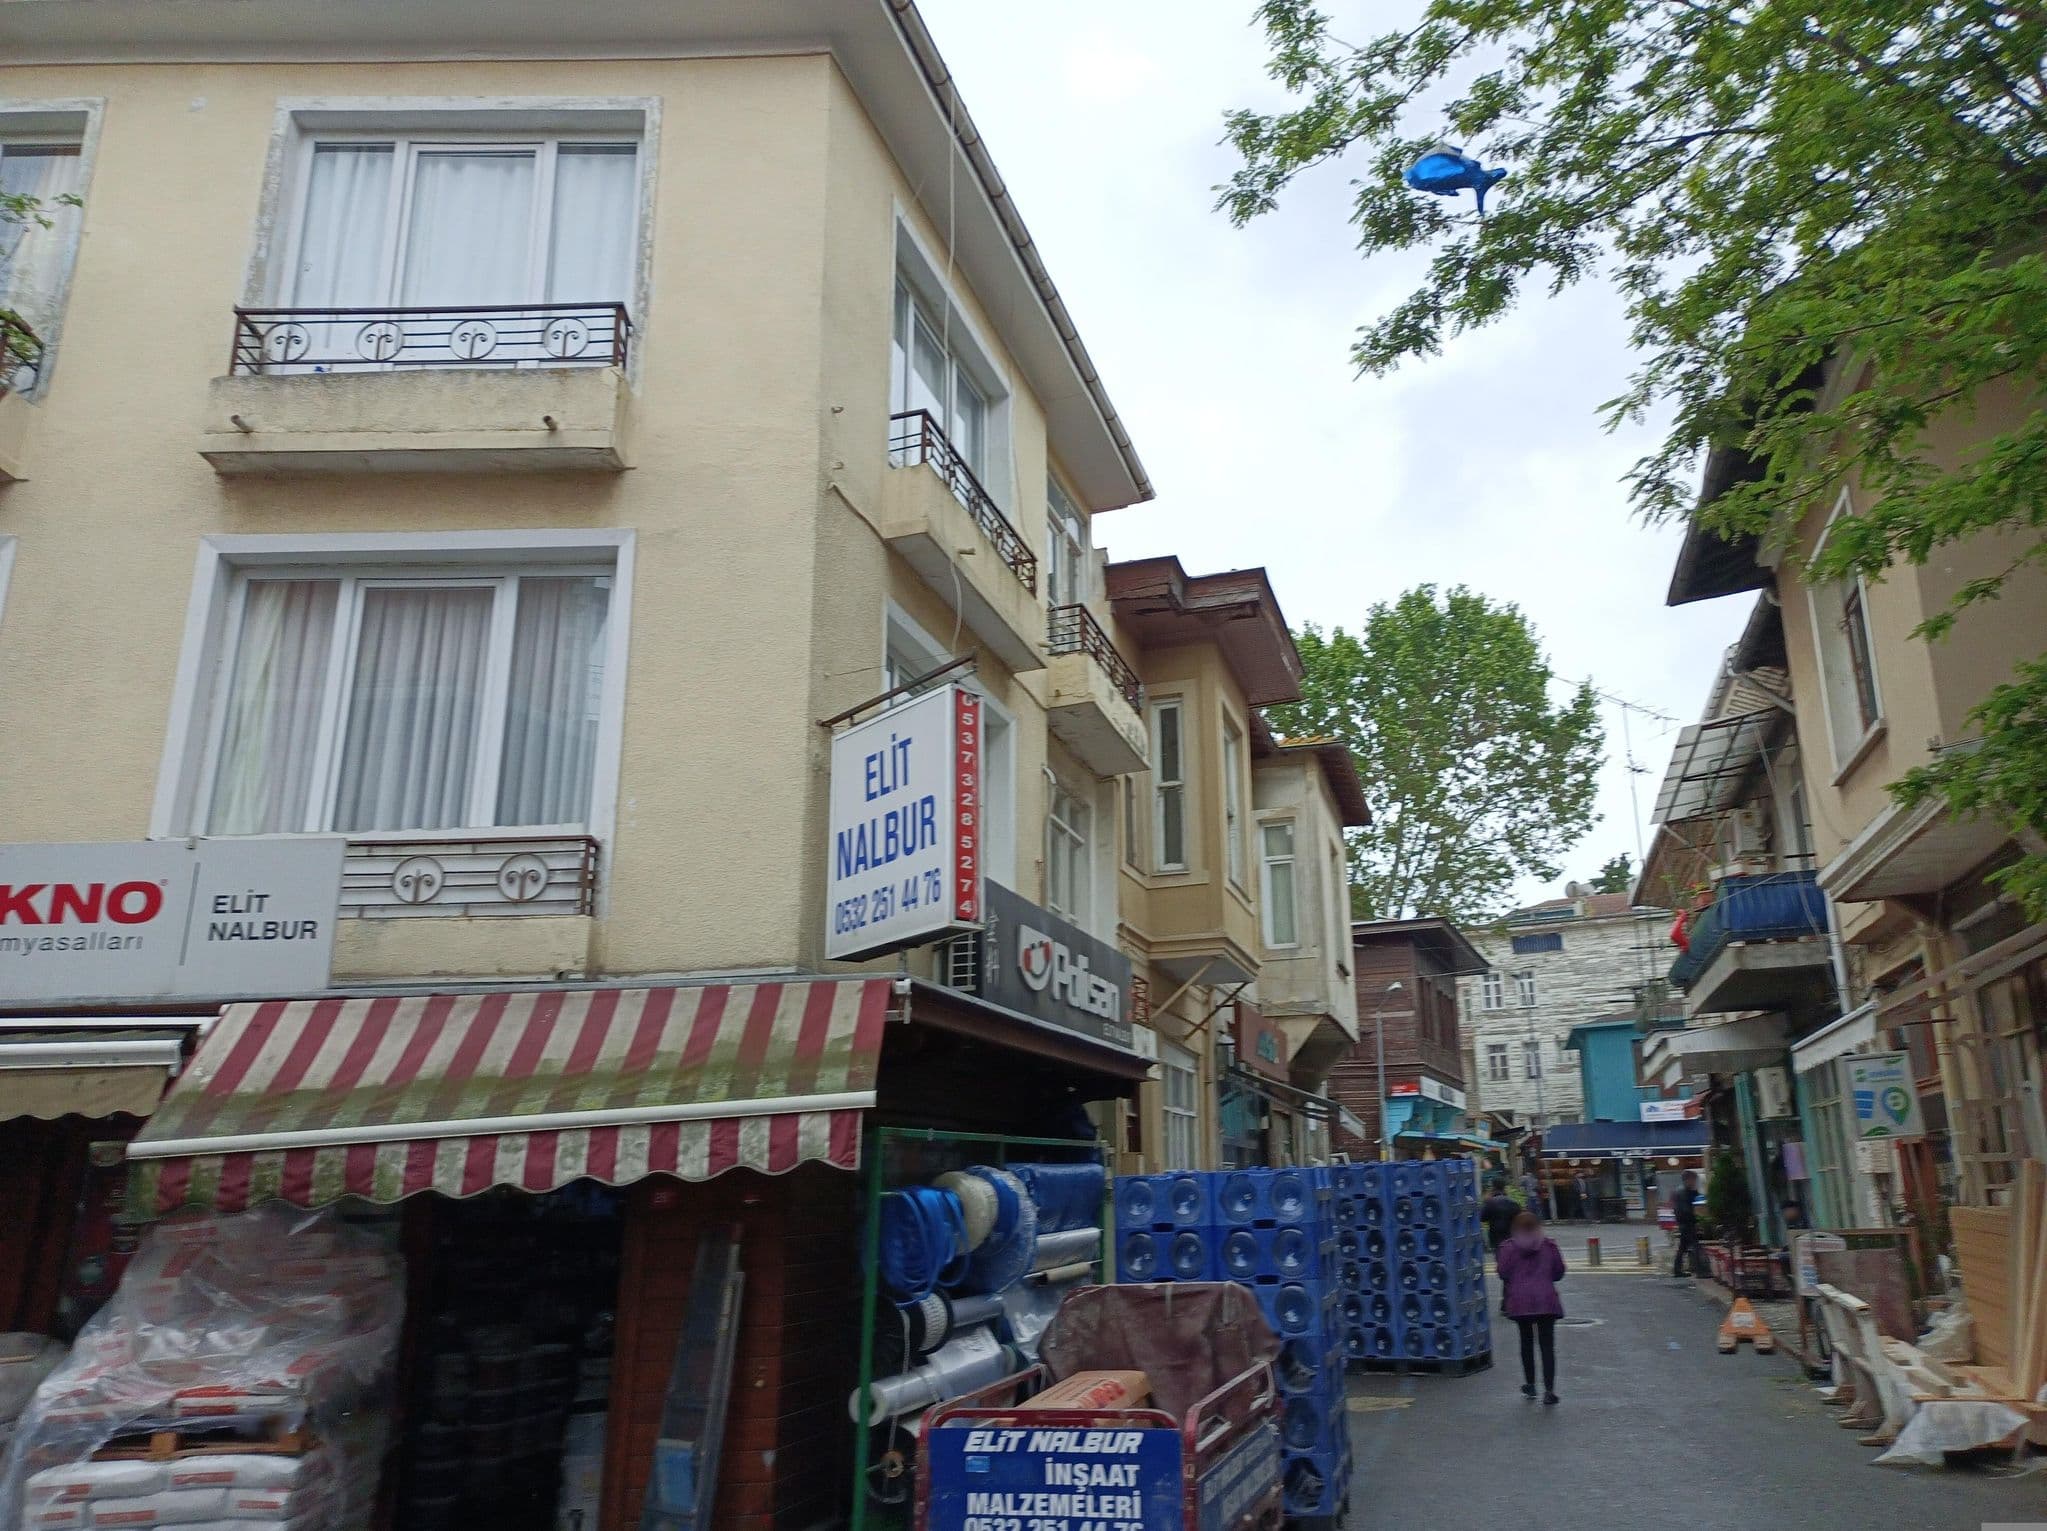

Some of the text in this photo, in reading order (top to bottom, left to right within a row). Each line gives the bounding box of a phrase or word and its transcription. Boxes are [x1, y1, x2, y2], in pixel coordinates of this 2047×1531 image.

[865, 733, 912, 802] ELİT
[836, 794, 937, 882] NALBUR
[0, 881, 164, 925] KNO
[211, 889, 271, 915] ELİT
[834, 866, 942, 935] 0532 251 44 76
[0, 931, 144, 957] myasalları
[207, 920, 319, 942] NALBUR
[1026, 1430, 1144, 1454] NALBUR
[1044, 1457, 1141, 1494] İNŞAAT
[966, 1490, 1143, 1521] MALZEMELERİ
